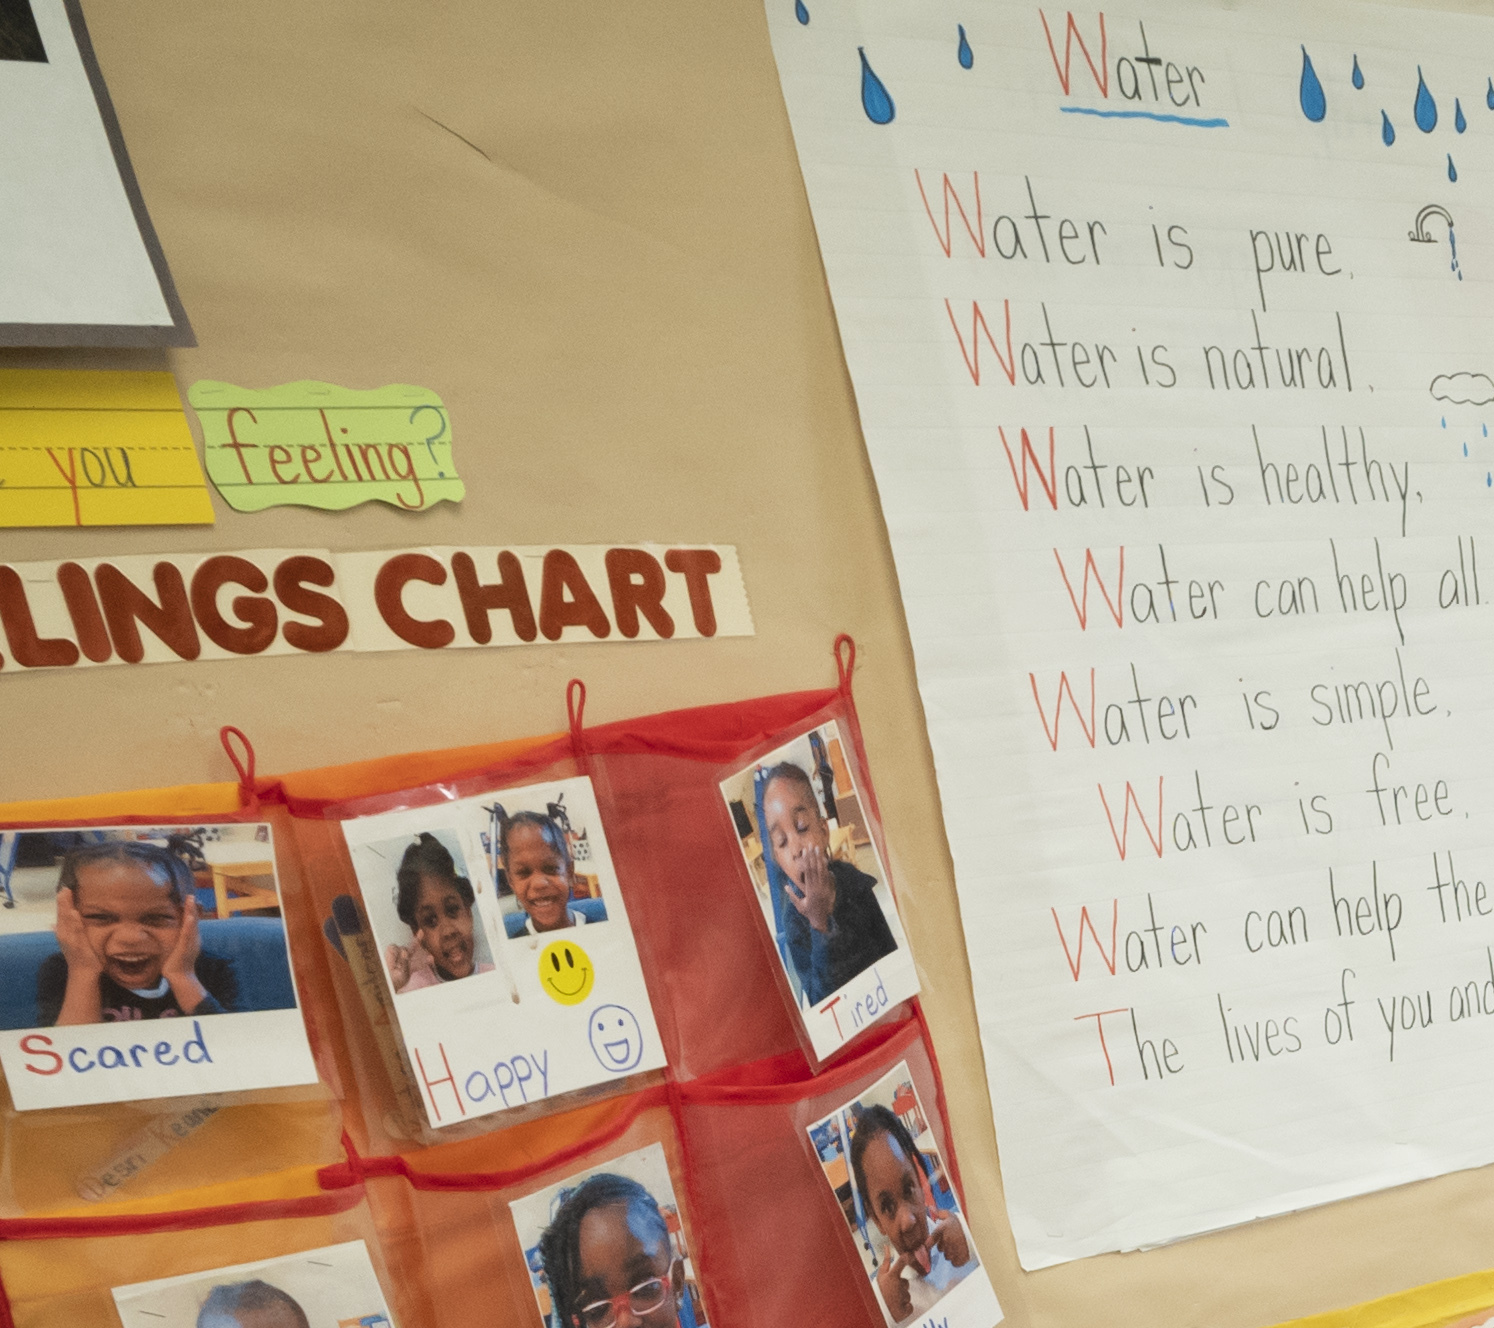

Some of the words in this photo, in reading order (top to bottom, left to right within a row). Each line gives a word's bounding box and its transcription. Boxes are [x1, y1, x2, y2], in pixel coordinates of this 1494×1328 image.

[1039, 8, 1204, 107] Water
[916, 168, 1106, 265] Water
[1149, 206, 1193, 269] is
[945, 298, 1115, 388] Water
[1132, 328, 1176, 387] is
[48, 447, 136, 526] you
[222, 405, 447, 510] feeling?
[999, 424, 1153, 511] Water
[1194, 448, 1234, 506] is
[0, 554, 350, 671] LINGS
[374, 548, 722, 649] CHART
[1053, 544, 1224, 631] Water
[1255, 582, 1319, 618] can
[1331, 538, 1408, 645] help
[1030, 662, 1197, 751] Water
[1239, 678, 1280, 730] is
[1098, 770, 1262, 861] Water
[1294, 782, 1333, 834] is
[1052, 893, 1208, 982] Water
[1245, 905, 1309, 953] can
[1330, 860, 1402, 961] help
[1428, 851, 1493, 923] the
[19, 1020, 213, 1077] Scared
[820, 980, 889, 1042] Tired
[1074, 1007, 1185, 1085] The
[1218, 993, 1301, 1064] lives
[1324, 967, 1356, 1044] of
[1378, 990, 1433, 1061] you
[414, 1043, 548, 1122] Happy
